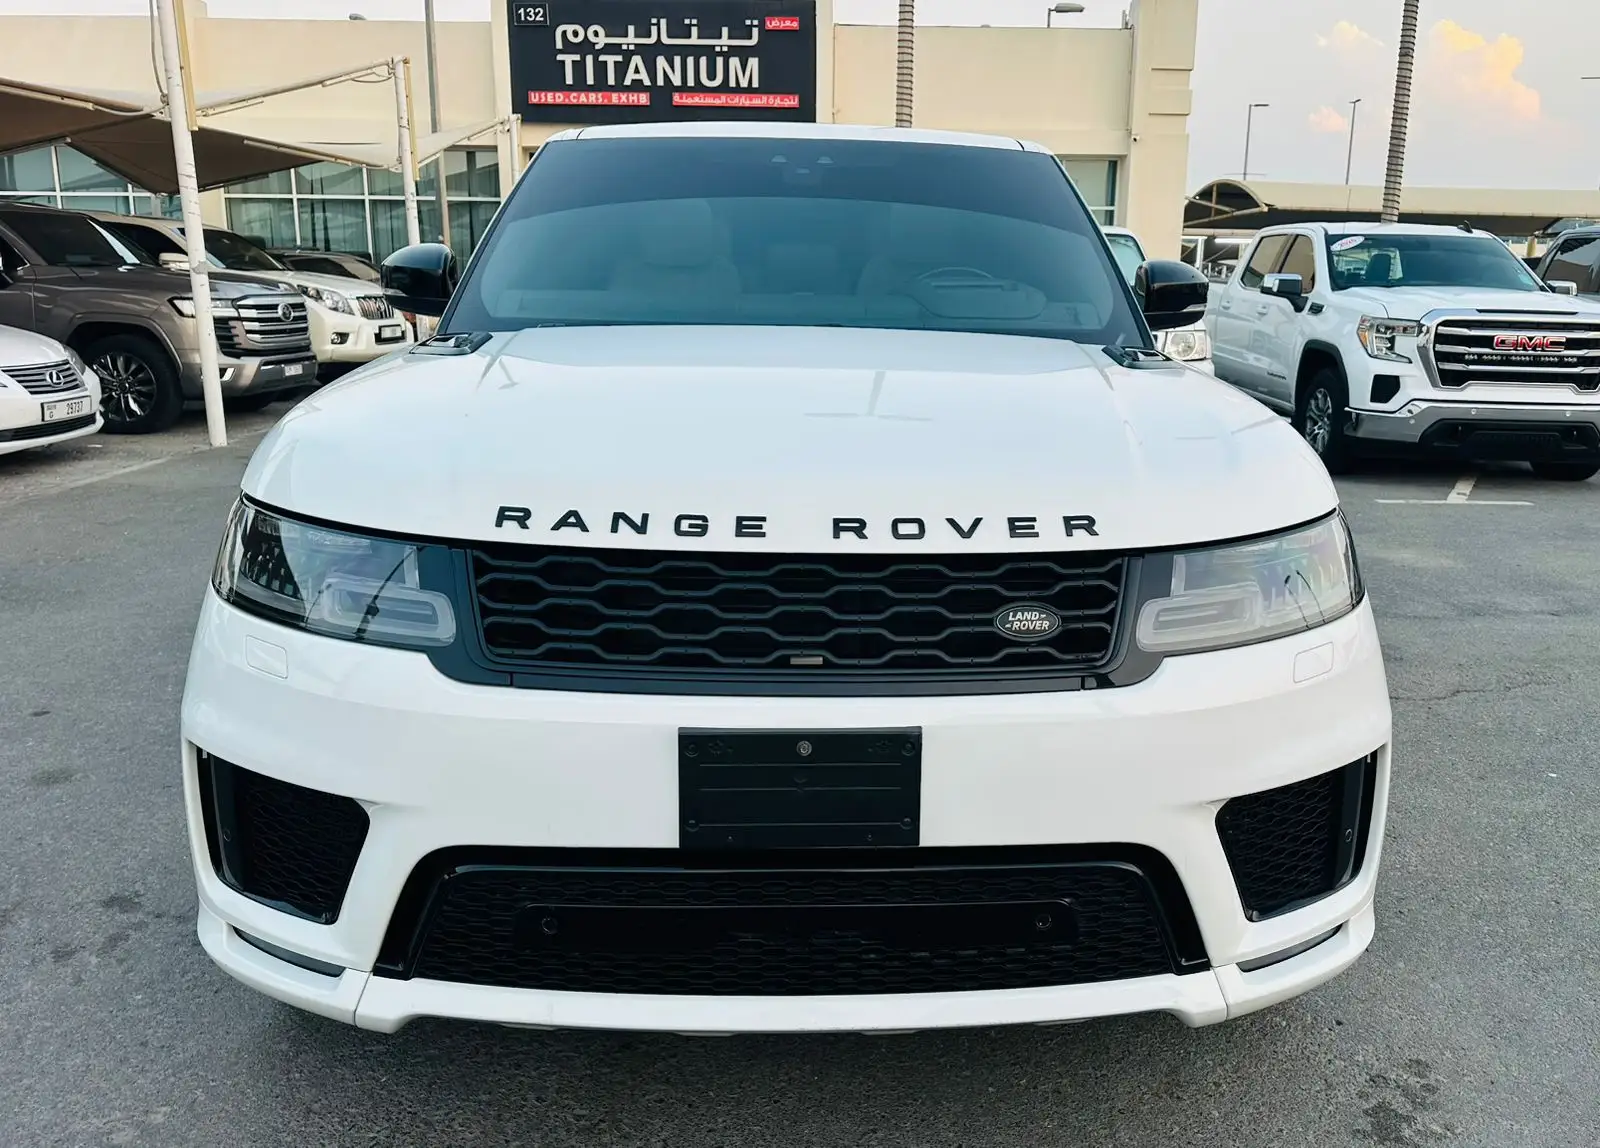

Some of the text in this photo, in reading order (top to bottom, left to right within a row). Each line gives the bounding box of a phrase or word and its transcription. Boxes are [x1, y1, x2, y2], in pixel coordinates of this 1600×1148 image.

[517, 7, 544, 21] 132
[766, 18, 798, 29] معرض
[555, 17, 759, 51] تيتانيوم
[556, 54, 759, 88] TITANIUM
[672, 92, 726, 105] المستعملة
[727, 94, 767, 106] السيارات
[1493, 335, 1567, 350] GMC
[495, 506, 1100, 539] RANGE ROVER
[1008, 611, 1040, 621] LAND
[1012, 620, 1050, 631] ROVER
